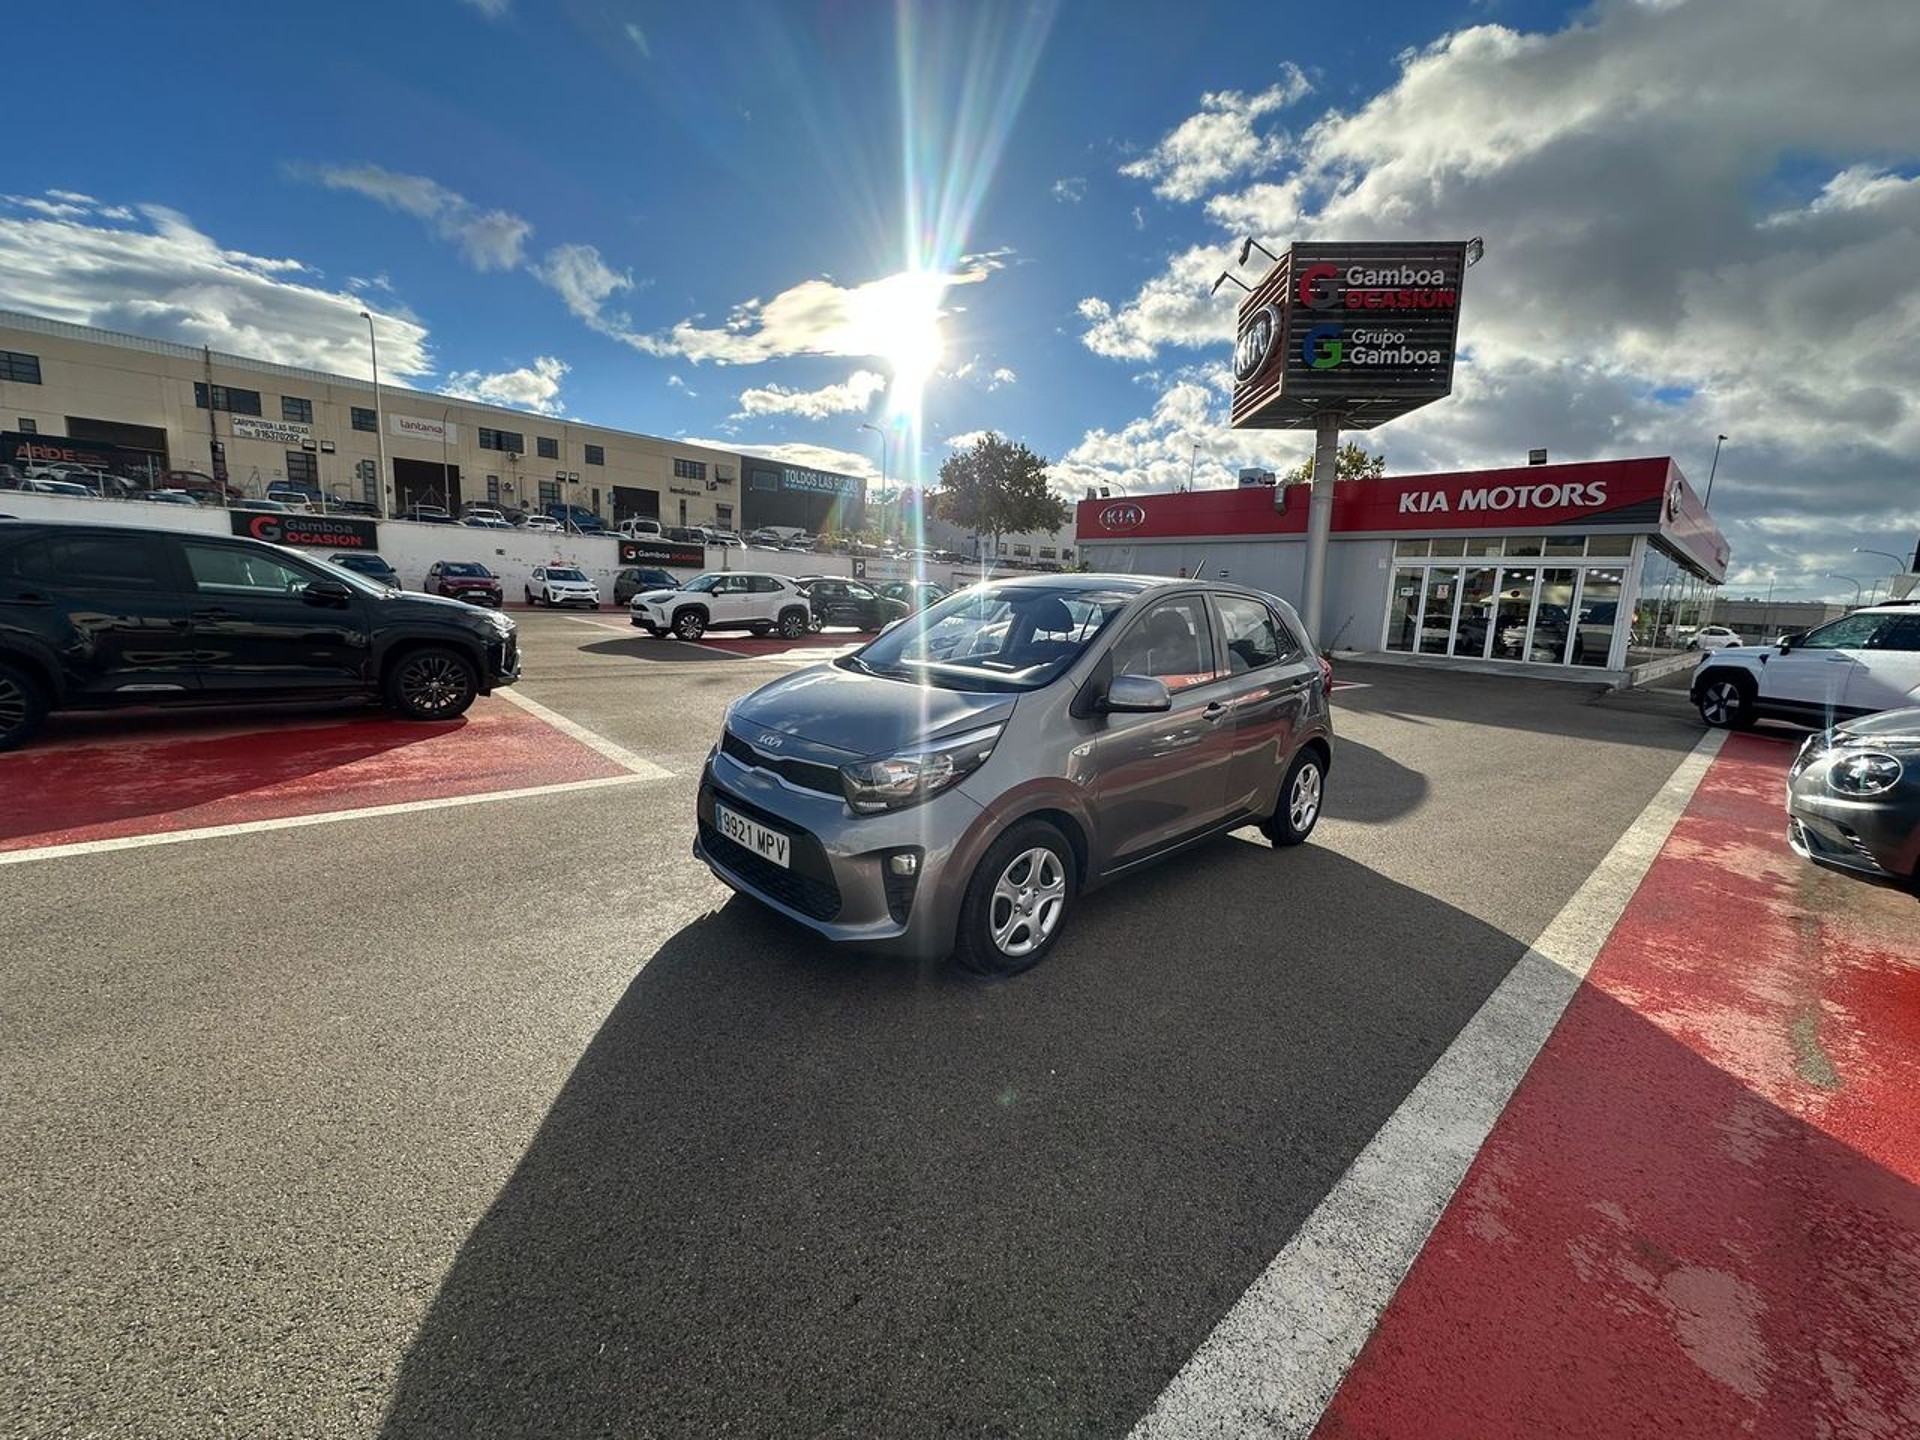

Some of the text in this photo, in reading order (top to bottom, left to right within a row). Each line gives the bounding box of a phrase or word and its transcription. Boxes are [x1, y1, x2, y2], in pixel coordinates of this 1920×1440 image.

[1346, 265, 1445, 286] Gamboa
[1344, 288, 1456, 309] OCASION
[1352, 329, 1405, 349] Grupo
[1350, 346, 1441, 365] Gamboa
[784, 469, 817, 487] TOLDOS
[818, 474, 834, 490] LAS
[1399, 481, 1607, 513] KIA MOTORS
[284, 519, 354, 533] Gamboa
[1106, 509, 1137, 524] KIA
[286, 531, 362, 546] OCASION
[638, 549, 670, 559] Gamboa
[723, 812, 786, 861] 9921 MPV
